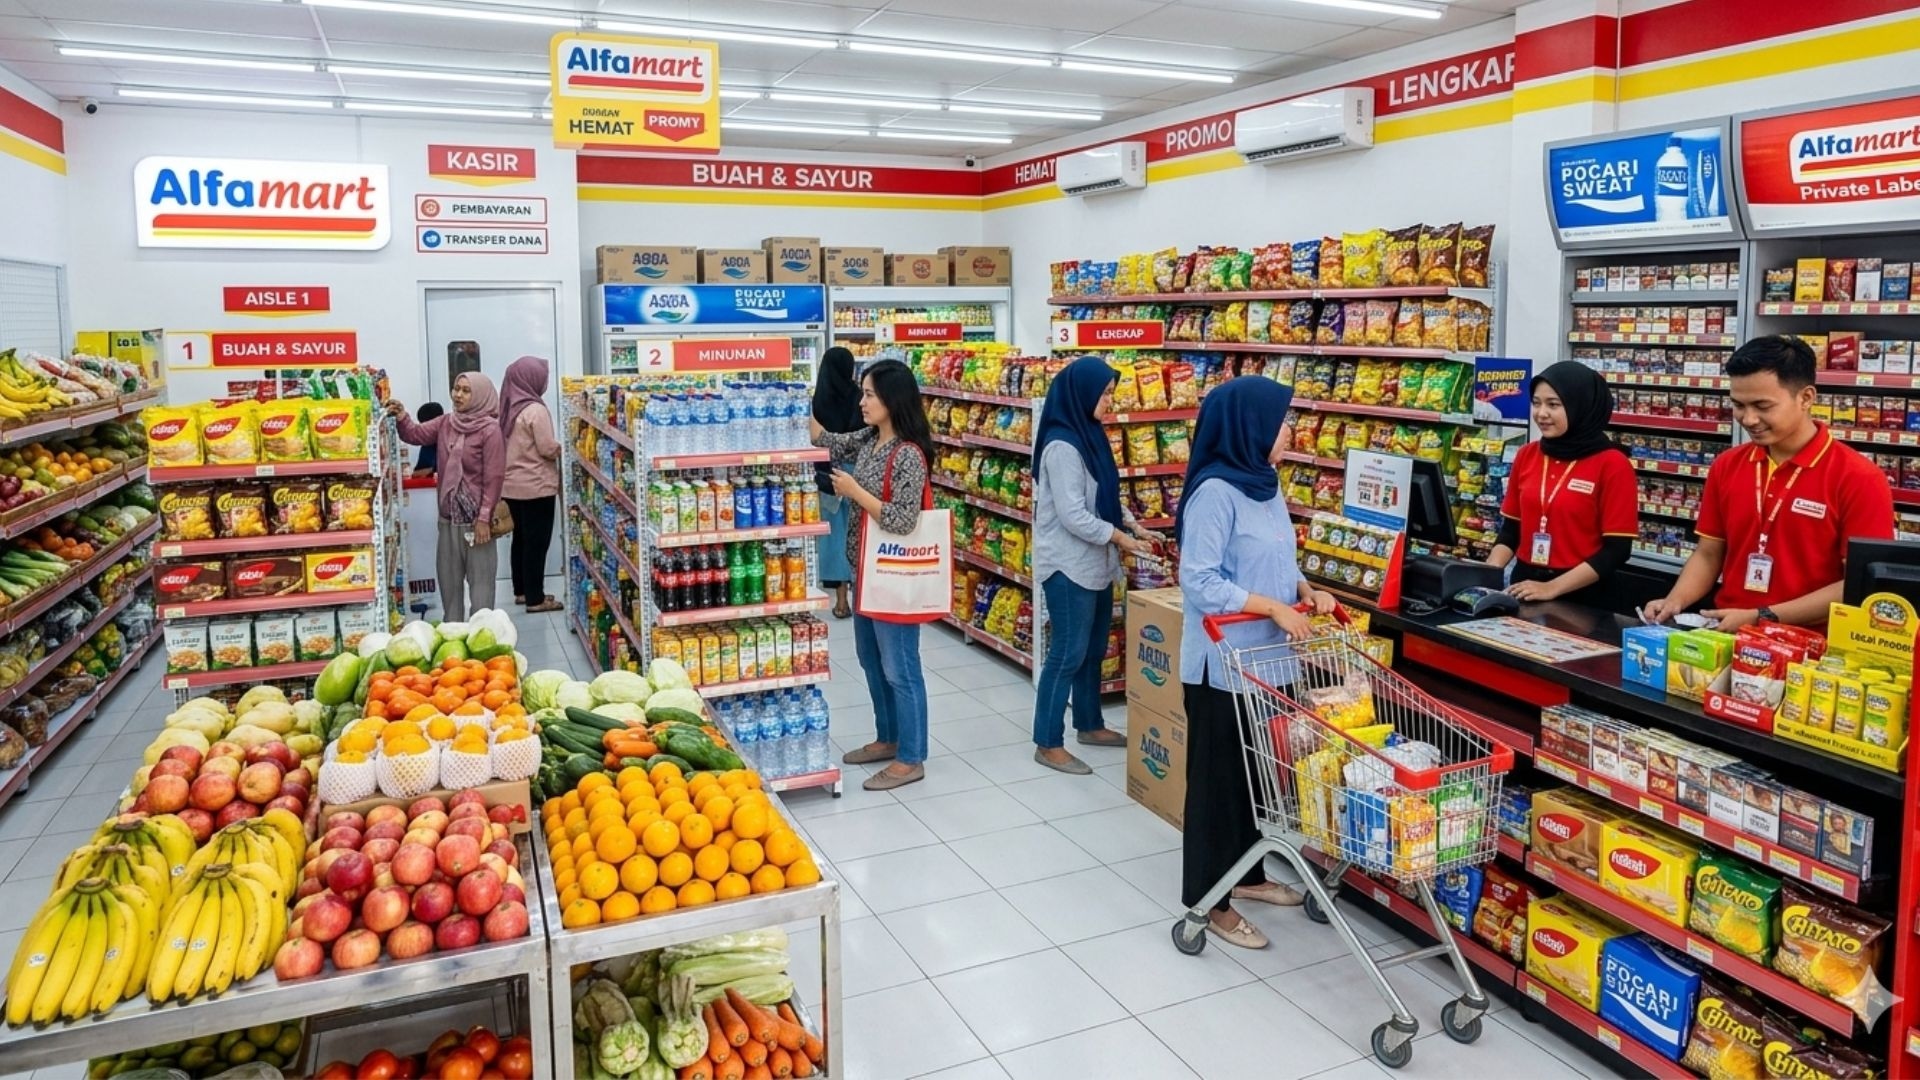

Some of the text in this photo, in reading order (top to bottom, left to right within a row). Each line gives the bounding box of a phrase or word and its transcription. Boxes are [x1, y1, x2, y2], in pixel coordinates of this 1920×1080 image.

[567, 47, 703, 78] Alfamart
[569, 119, 634, 135] HEMAT
[648, 115, 701, 129] PROMY
[1166, 119, 1233, 153] PROMO
[1798, 125, 1920, 159] Alfamart
[447, 151, 519, 171] KASIR
[1561, 159, 1639, 182] POCARI
[693, 164, 873, 189] BUAH & SAYUR
[1015, 158, 1056, 184] HEMAT
[150, 168, 376, 211] Alfamart
[1562, 177, 1634, 197] SWEAT
[1800, 184, 1870, 200] Private
[452, 204, 532, 215] PEMBAYARAN
[445, 235, 542, 246] TRANSPER DANA
[244, 292, 310, 305] AISLE 1
[1060, 329, 1069, 342] 3
[182, 342, 346, 360] 1 BUAH & SAYUR
[650, 348, 766, 365] 2 MINUMAN
